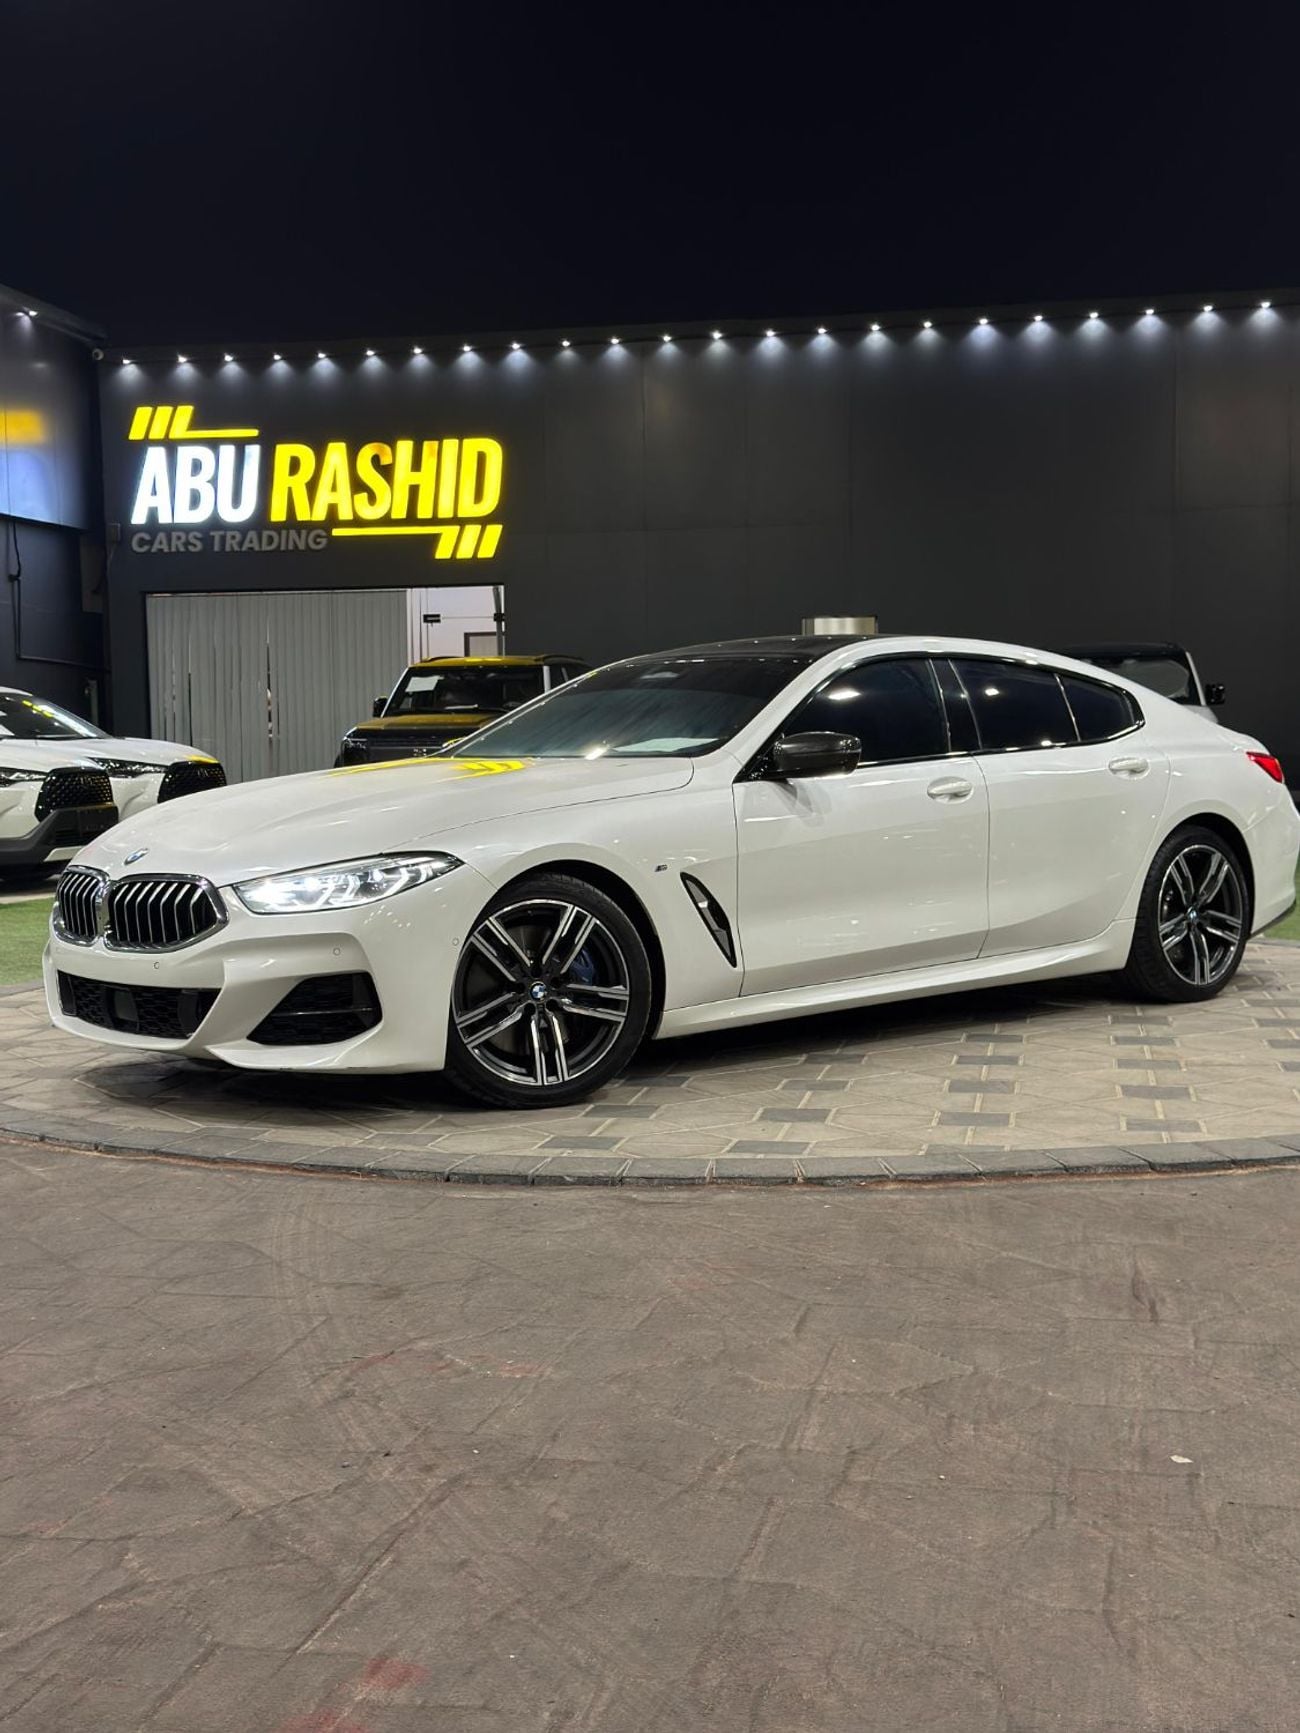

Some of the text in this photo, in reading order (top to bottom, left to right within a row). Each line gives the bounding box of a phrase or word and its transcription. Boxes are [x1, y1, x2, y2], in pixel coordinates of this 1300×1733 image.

[131, 437, 503, 525] ABU RASHID
[131, 529, 329, 553] CARS TRADING
